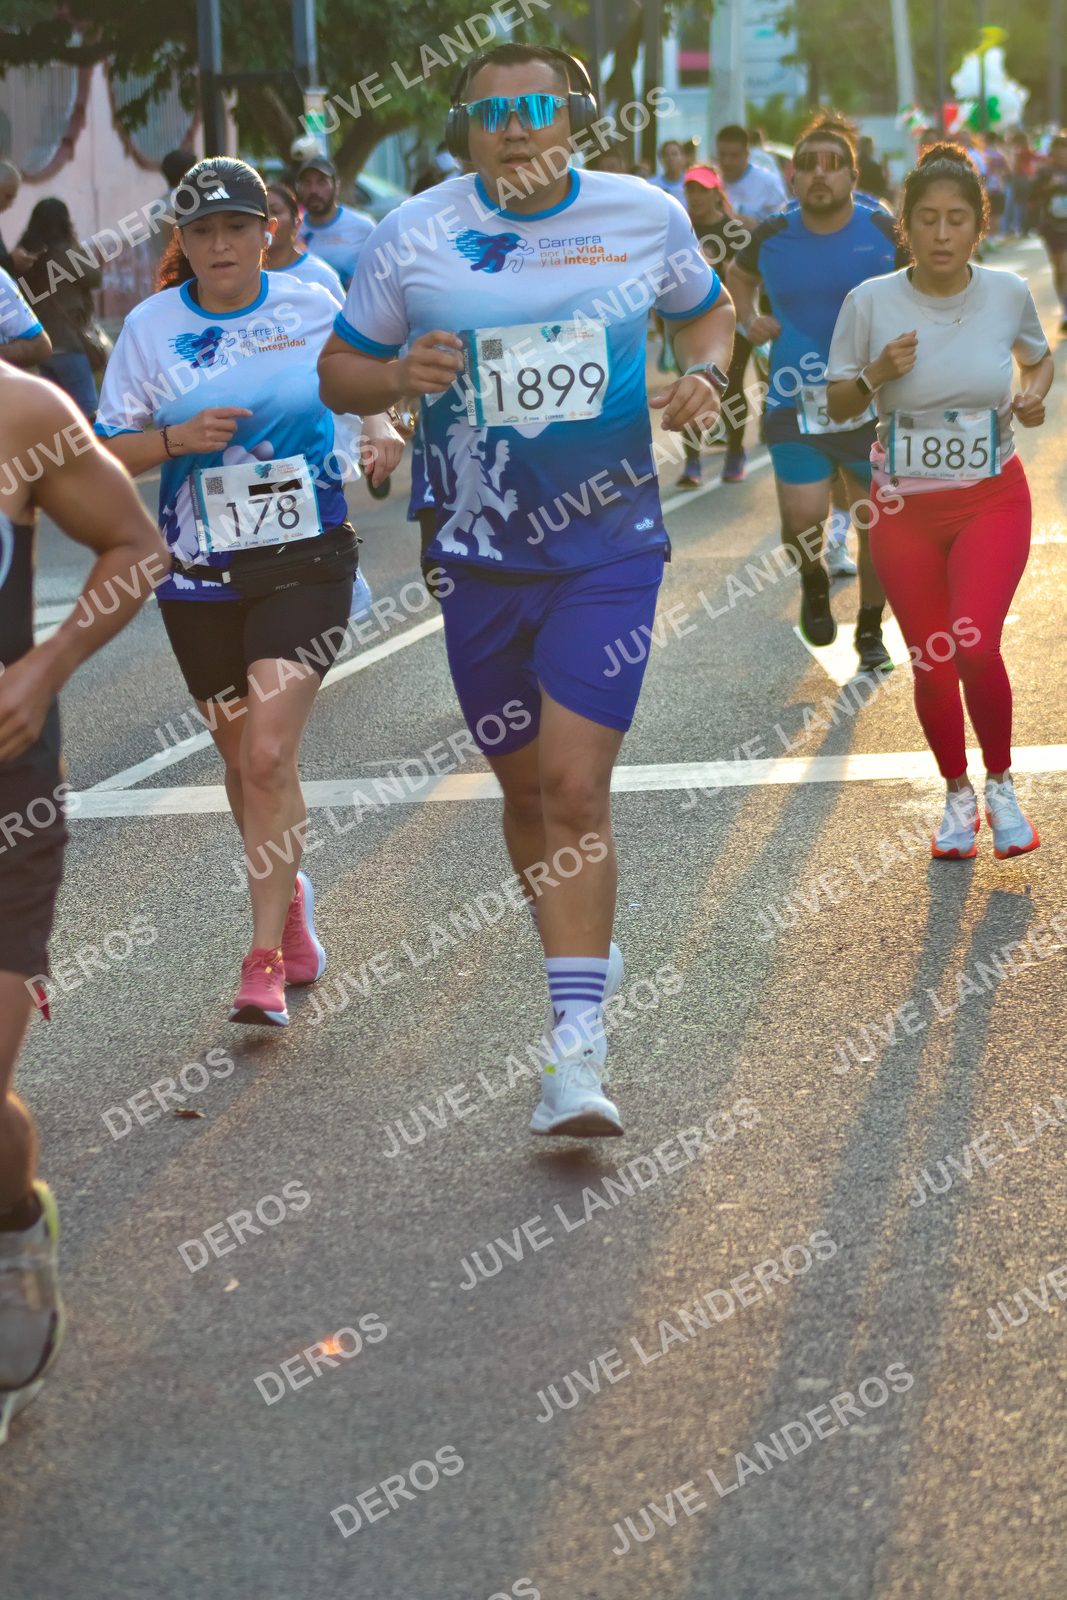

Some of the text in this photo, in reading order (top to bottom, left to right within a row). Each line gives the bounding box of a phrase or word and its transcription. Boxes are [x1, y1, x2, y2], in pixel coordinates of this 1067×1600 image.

[538, 235, 602, 249] Carrera
[564, 252, 628, 266] Integridad
[238, 326, 285, 339] Carrera
[258, 338, 306, 352] Integridad
[489, 362, 605, 412] 1899
[467, 400, 475, 417] 1899
[902, 436, 988, 470] 1885
[226, 494, 300, 538] 178
